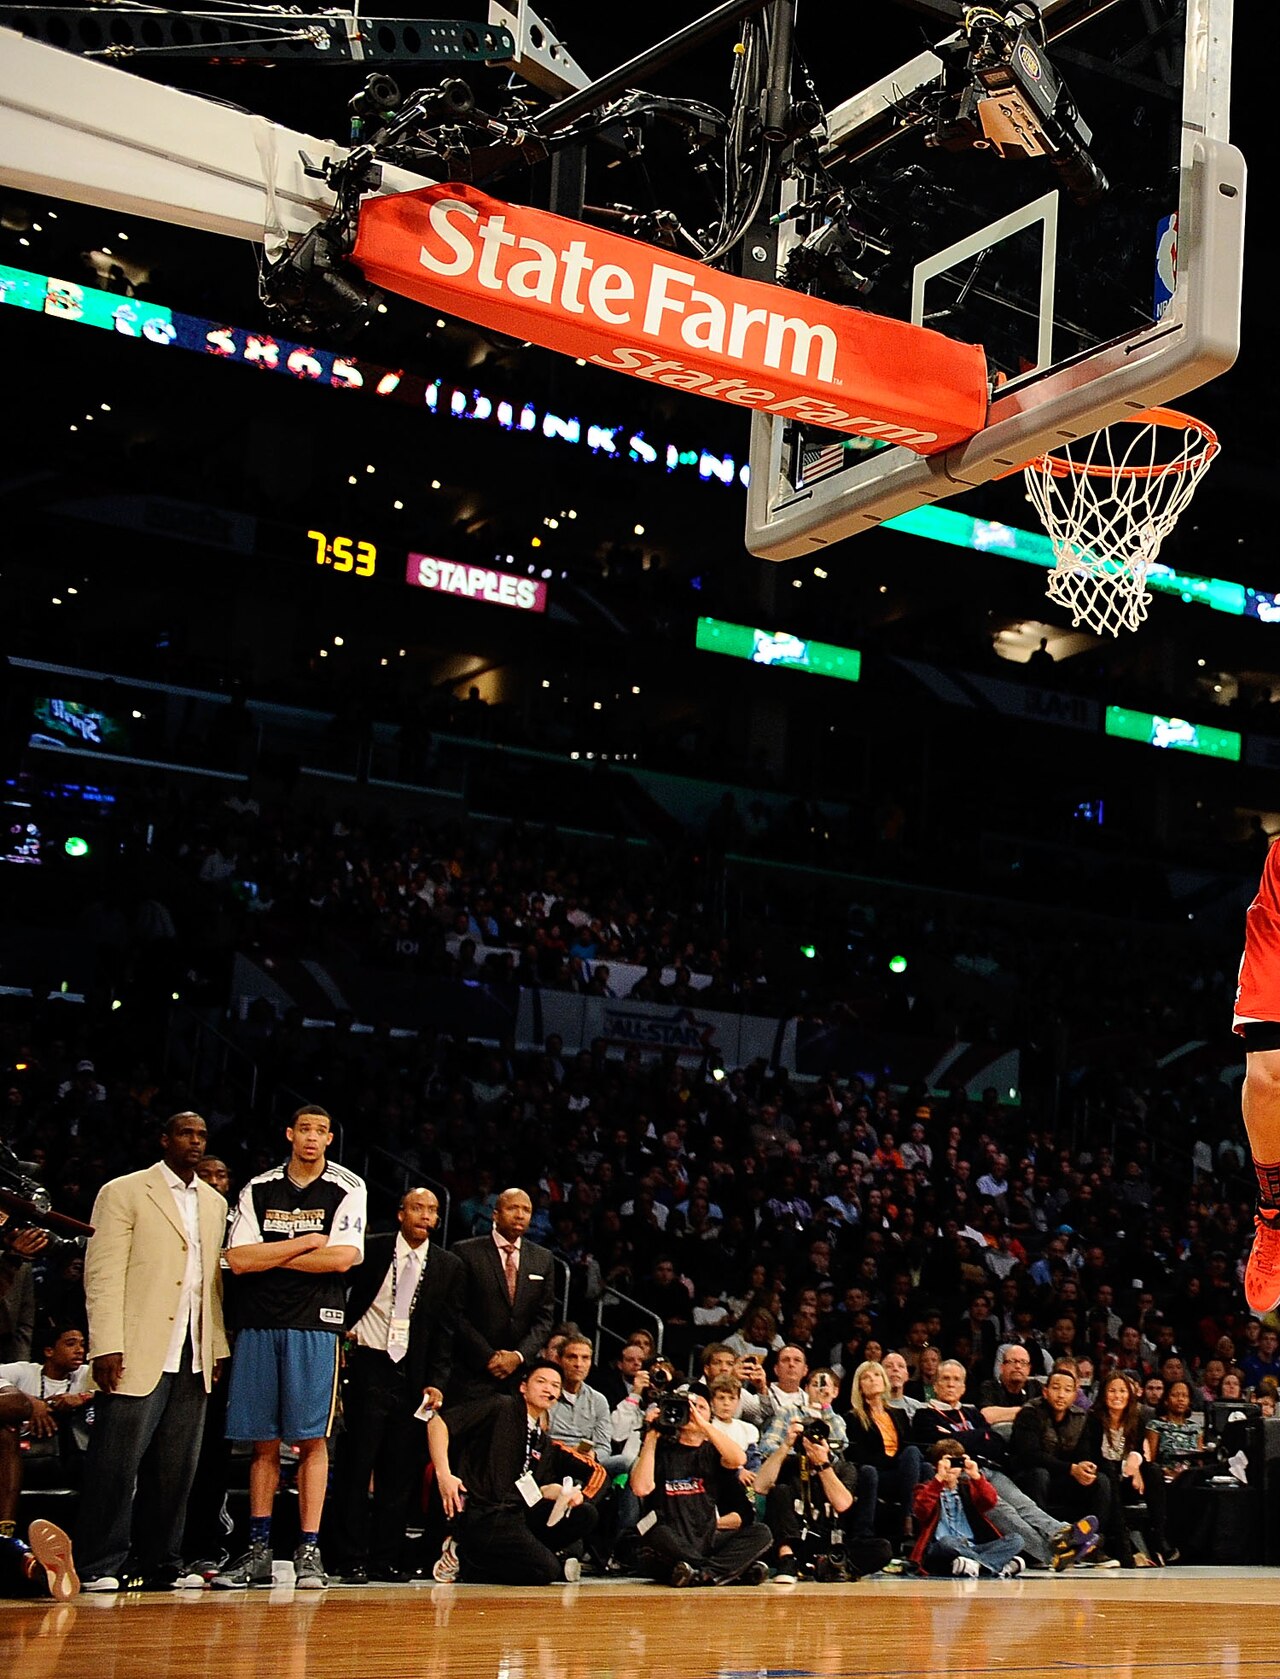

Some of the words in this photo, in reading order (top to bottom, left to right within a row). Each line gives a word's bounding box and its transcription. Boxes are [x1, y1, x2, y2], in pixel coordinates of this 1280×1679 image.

[419, 198, 635, 325] State
[642, 263, 838, 384] Farm
[588, 347, 776, 405] State
[762, 395, 939, 446] Farm
[308, 530, 377, 577] 7:53
[418, 557, 538, 610] STAPLES
[338, 1216, 362, 1233] 34
